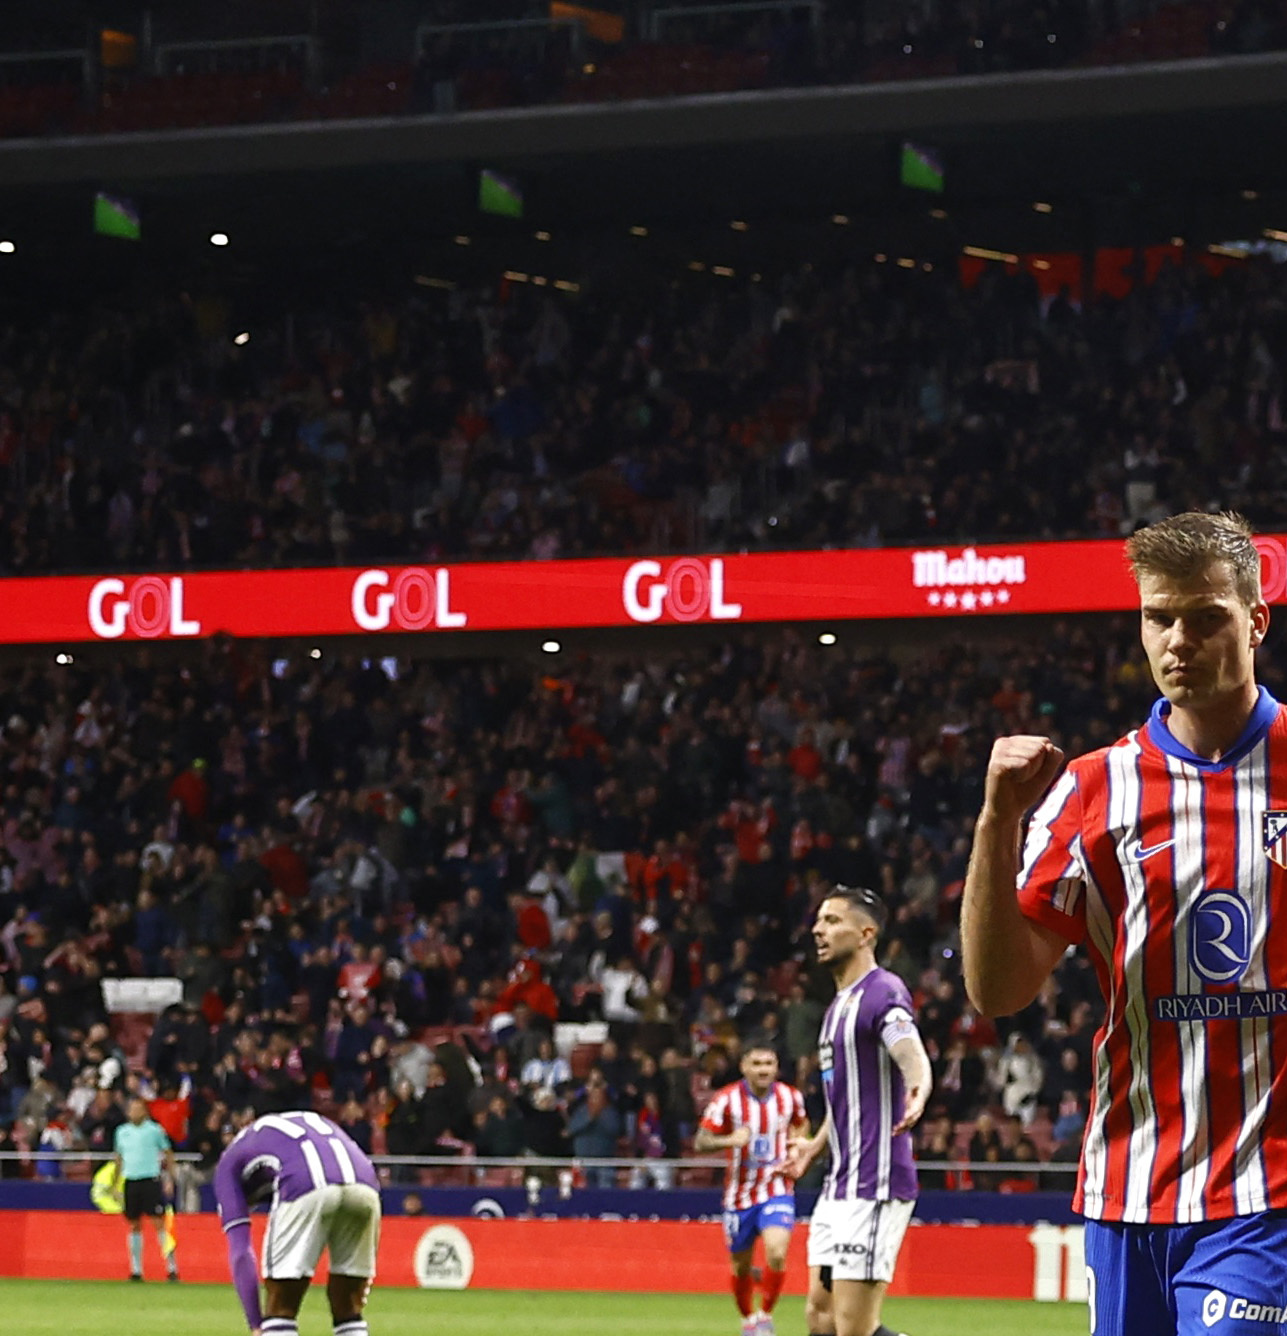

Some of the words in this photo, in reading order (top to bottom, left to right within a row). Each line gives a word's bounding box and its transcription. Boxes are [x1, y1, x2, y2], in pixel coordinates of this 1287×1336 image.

[622, 557, 743, 623] GOL
[912, 547, 1026, 587] Mahou
[88, 576, 200, 638] GOL
[351, 567, 467, 631] GOL
[1158, 996, 1241, 1018] RIYADH
[1250, 992, 1287, 1013] AIR
